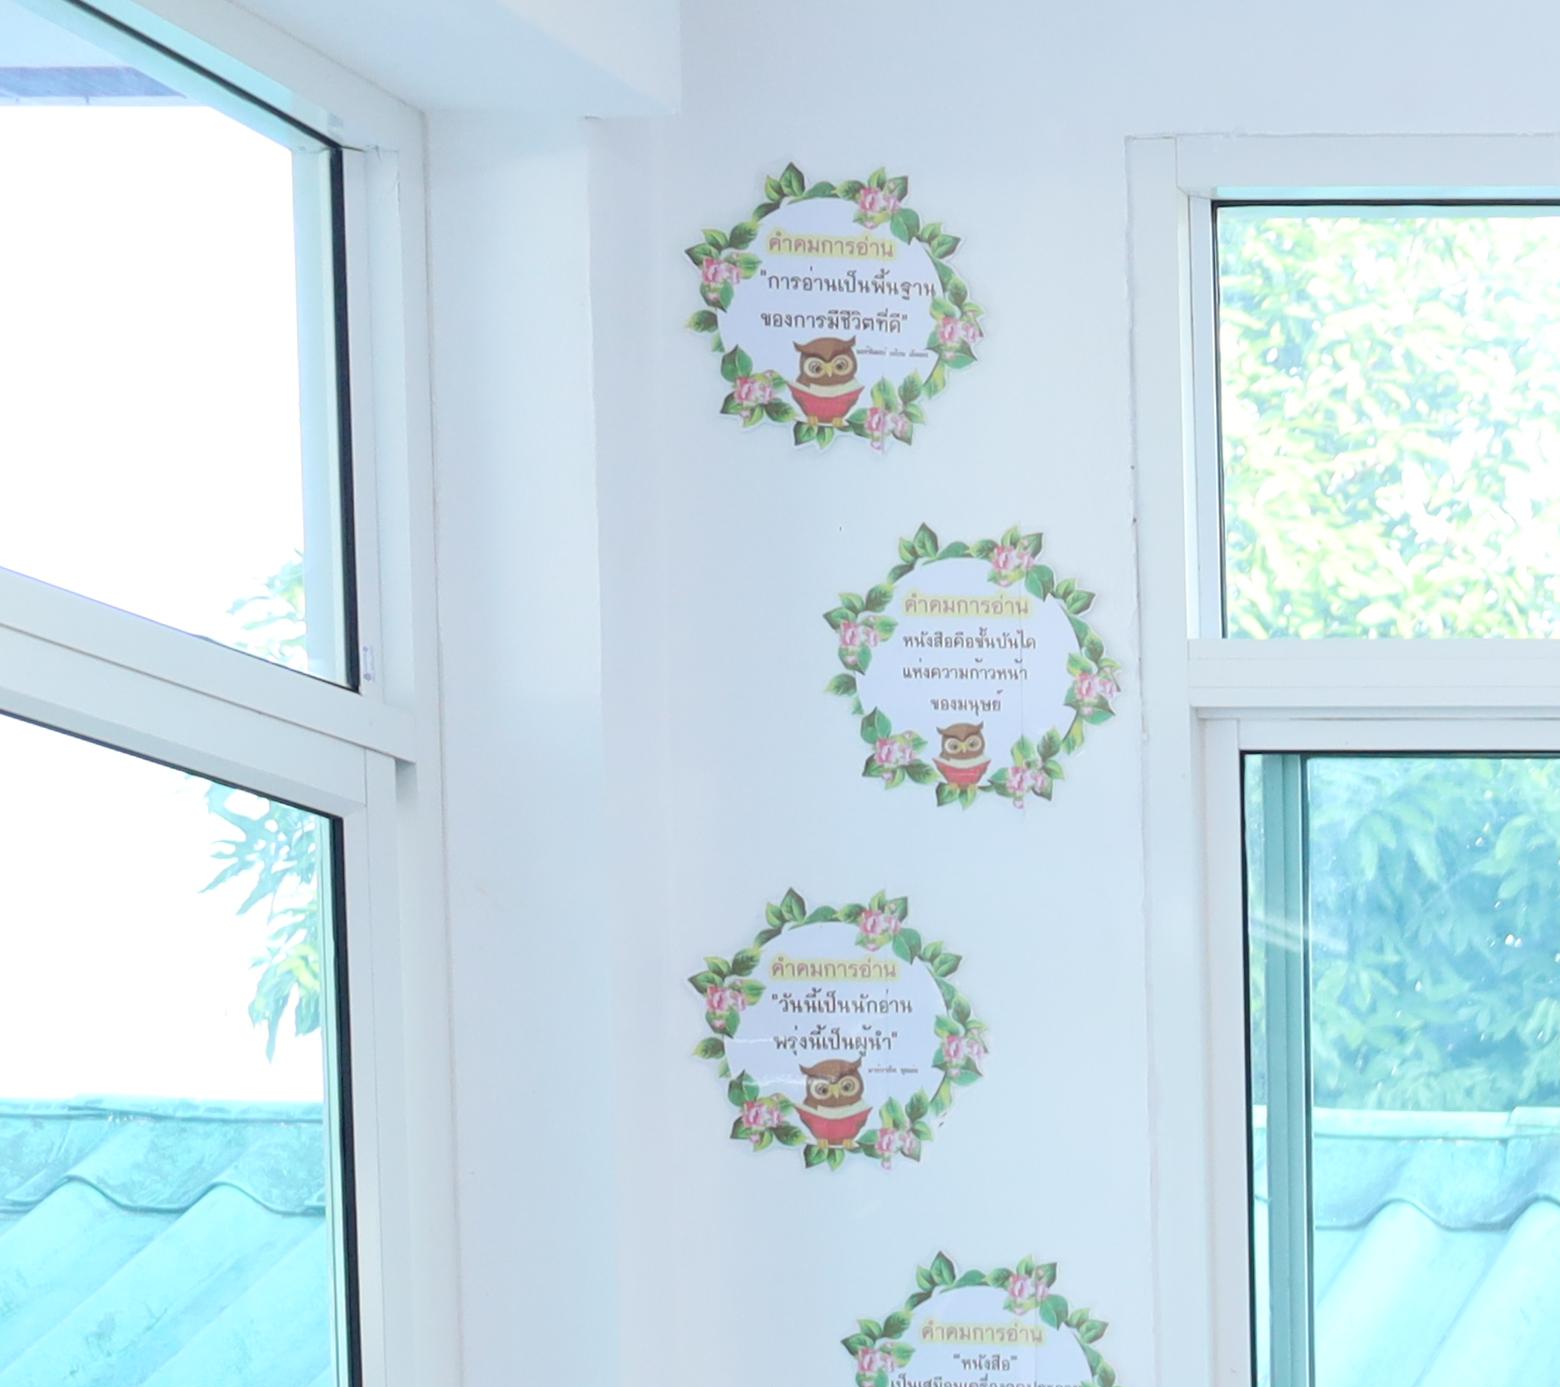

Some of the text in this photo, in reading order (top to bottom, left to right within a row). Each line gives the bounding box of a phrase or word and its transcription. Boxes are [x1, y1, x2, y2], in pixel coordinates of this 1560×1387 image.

[769, 232, 893, 257] คำคมการอ่าน
[905, 593, 1029, 615] คำคมการอ่าน
[903, 627, 1036, 649] หนังสือคือขั้นบันได
[903, 657, 1027, 680] แห่งความก้าวหน้า
[930, 689, 1003, 717] ของมนุษย์
[772, 957, 897, 978] คำคมการอ่าน
[922, 1320, 1042, 1342] คำคมการอ่าน
